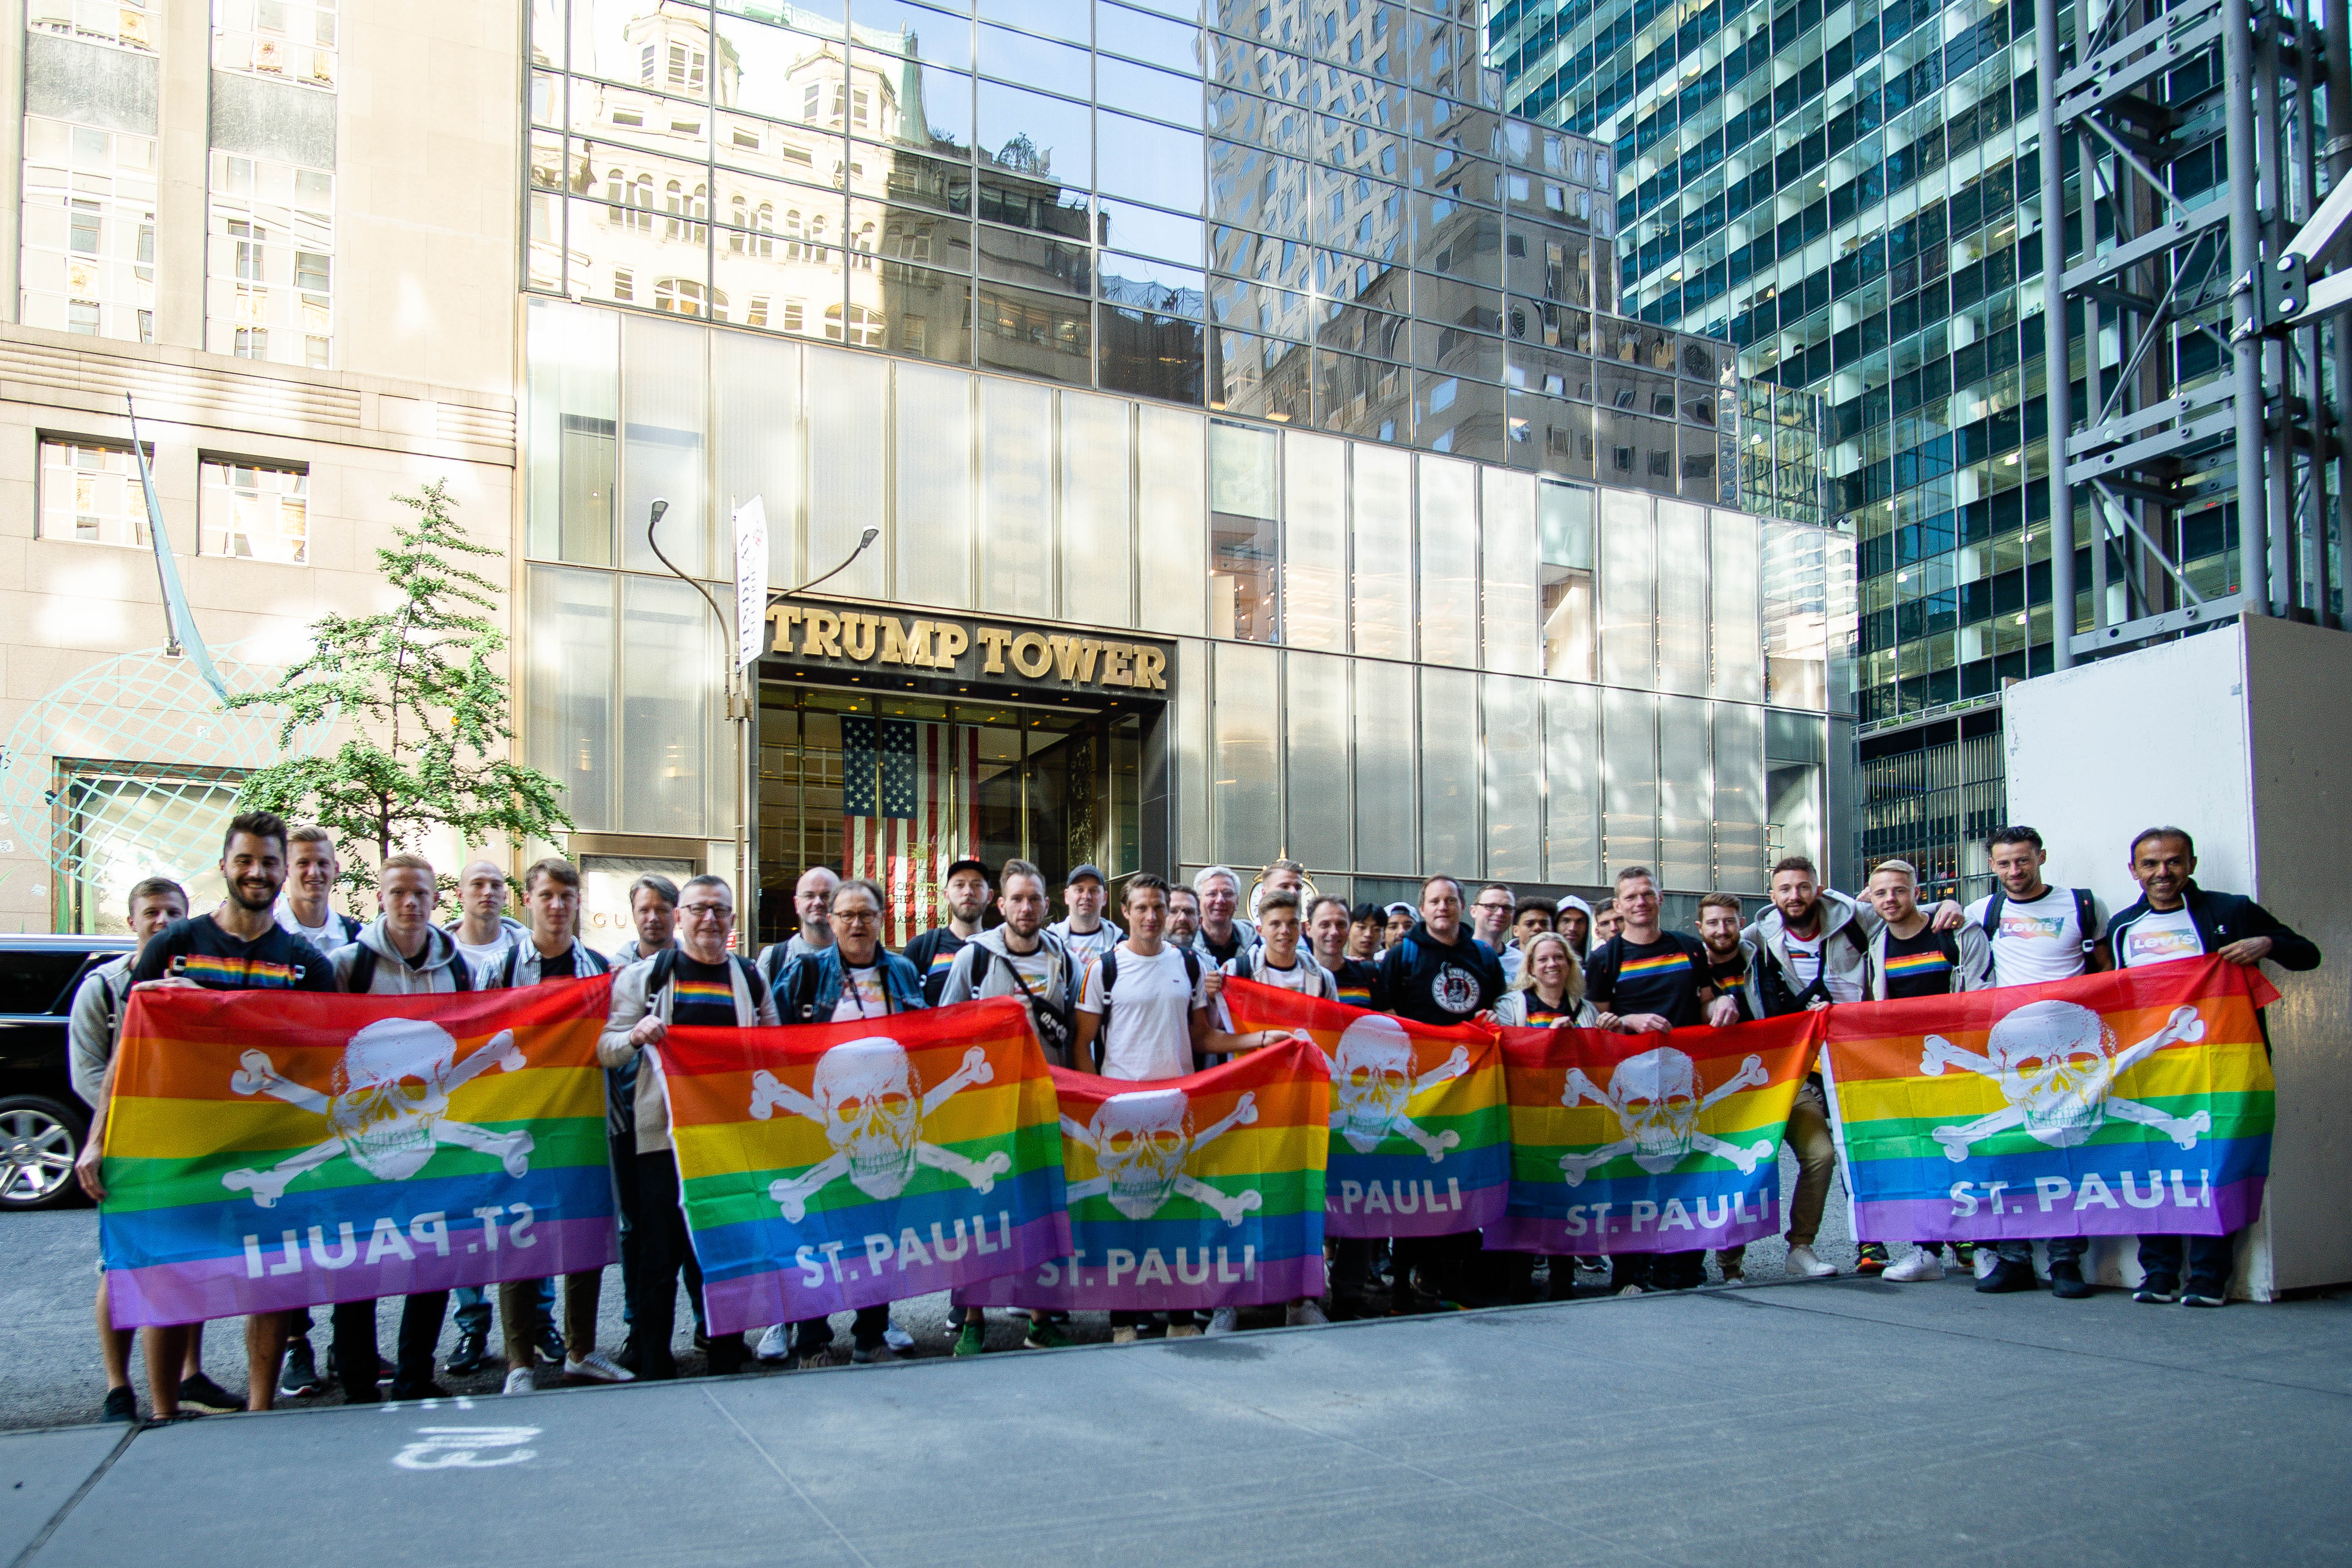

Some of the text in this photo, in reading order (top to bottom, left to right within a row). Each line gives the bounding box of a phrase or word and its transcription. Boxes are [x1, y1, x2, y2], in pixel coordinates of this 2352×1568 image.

[766, 605, 1166, 690] TRUMP TOWER
[1341, 1177, 1462, 1214] PAULI
[1565, 1188, 1769, 1236] ST. PAULI
[1950, 1169, 2211, 1217] ST. PAULI
[795, 1210, 1012, 1288] ST. PAULI
[1107, 1244, 1255, 1287] PAULI
